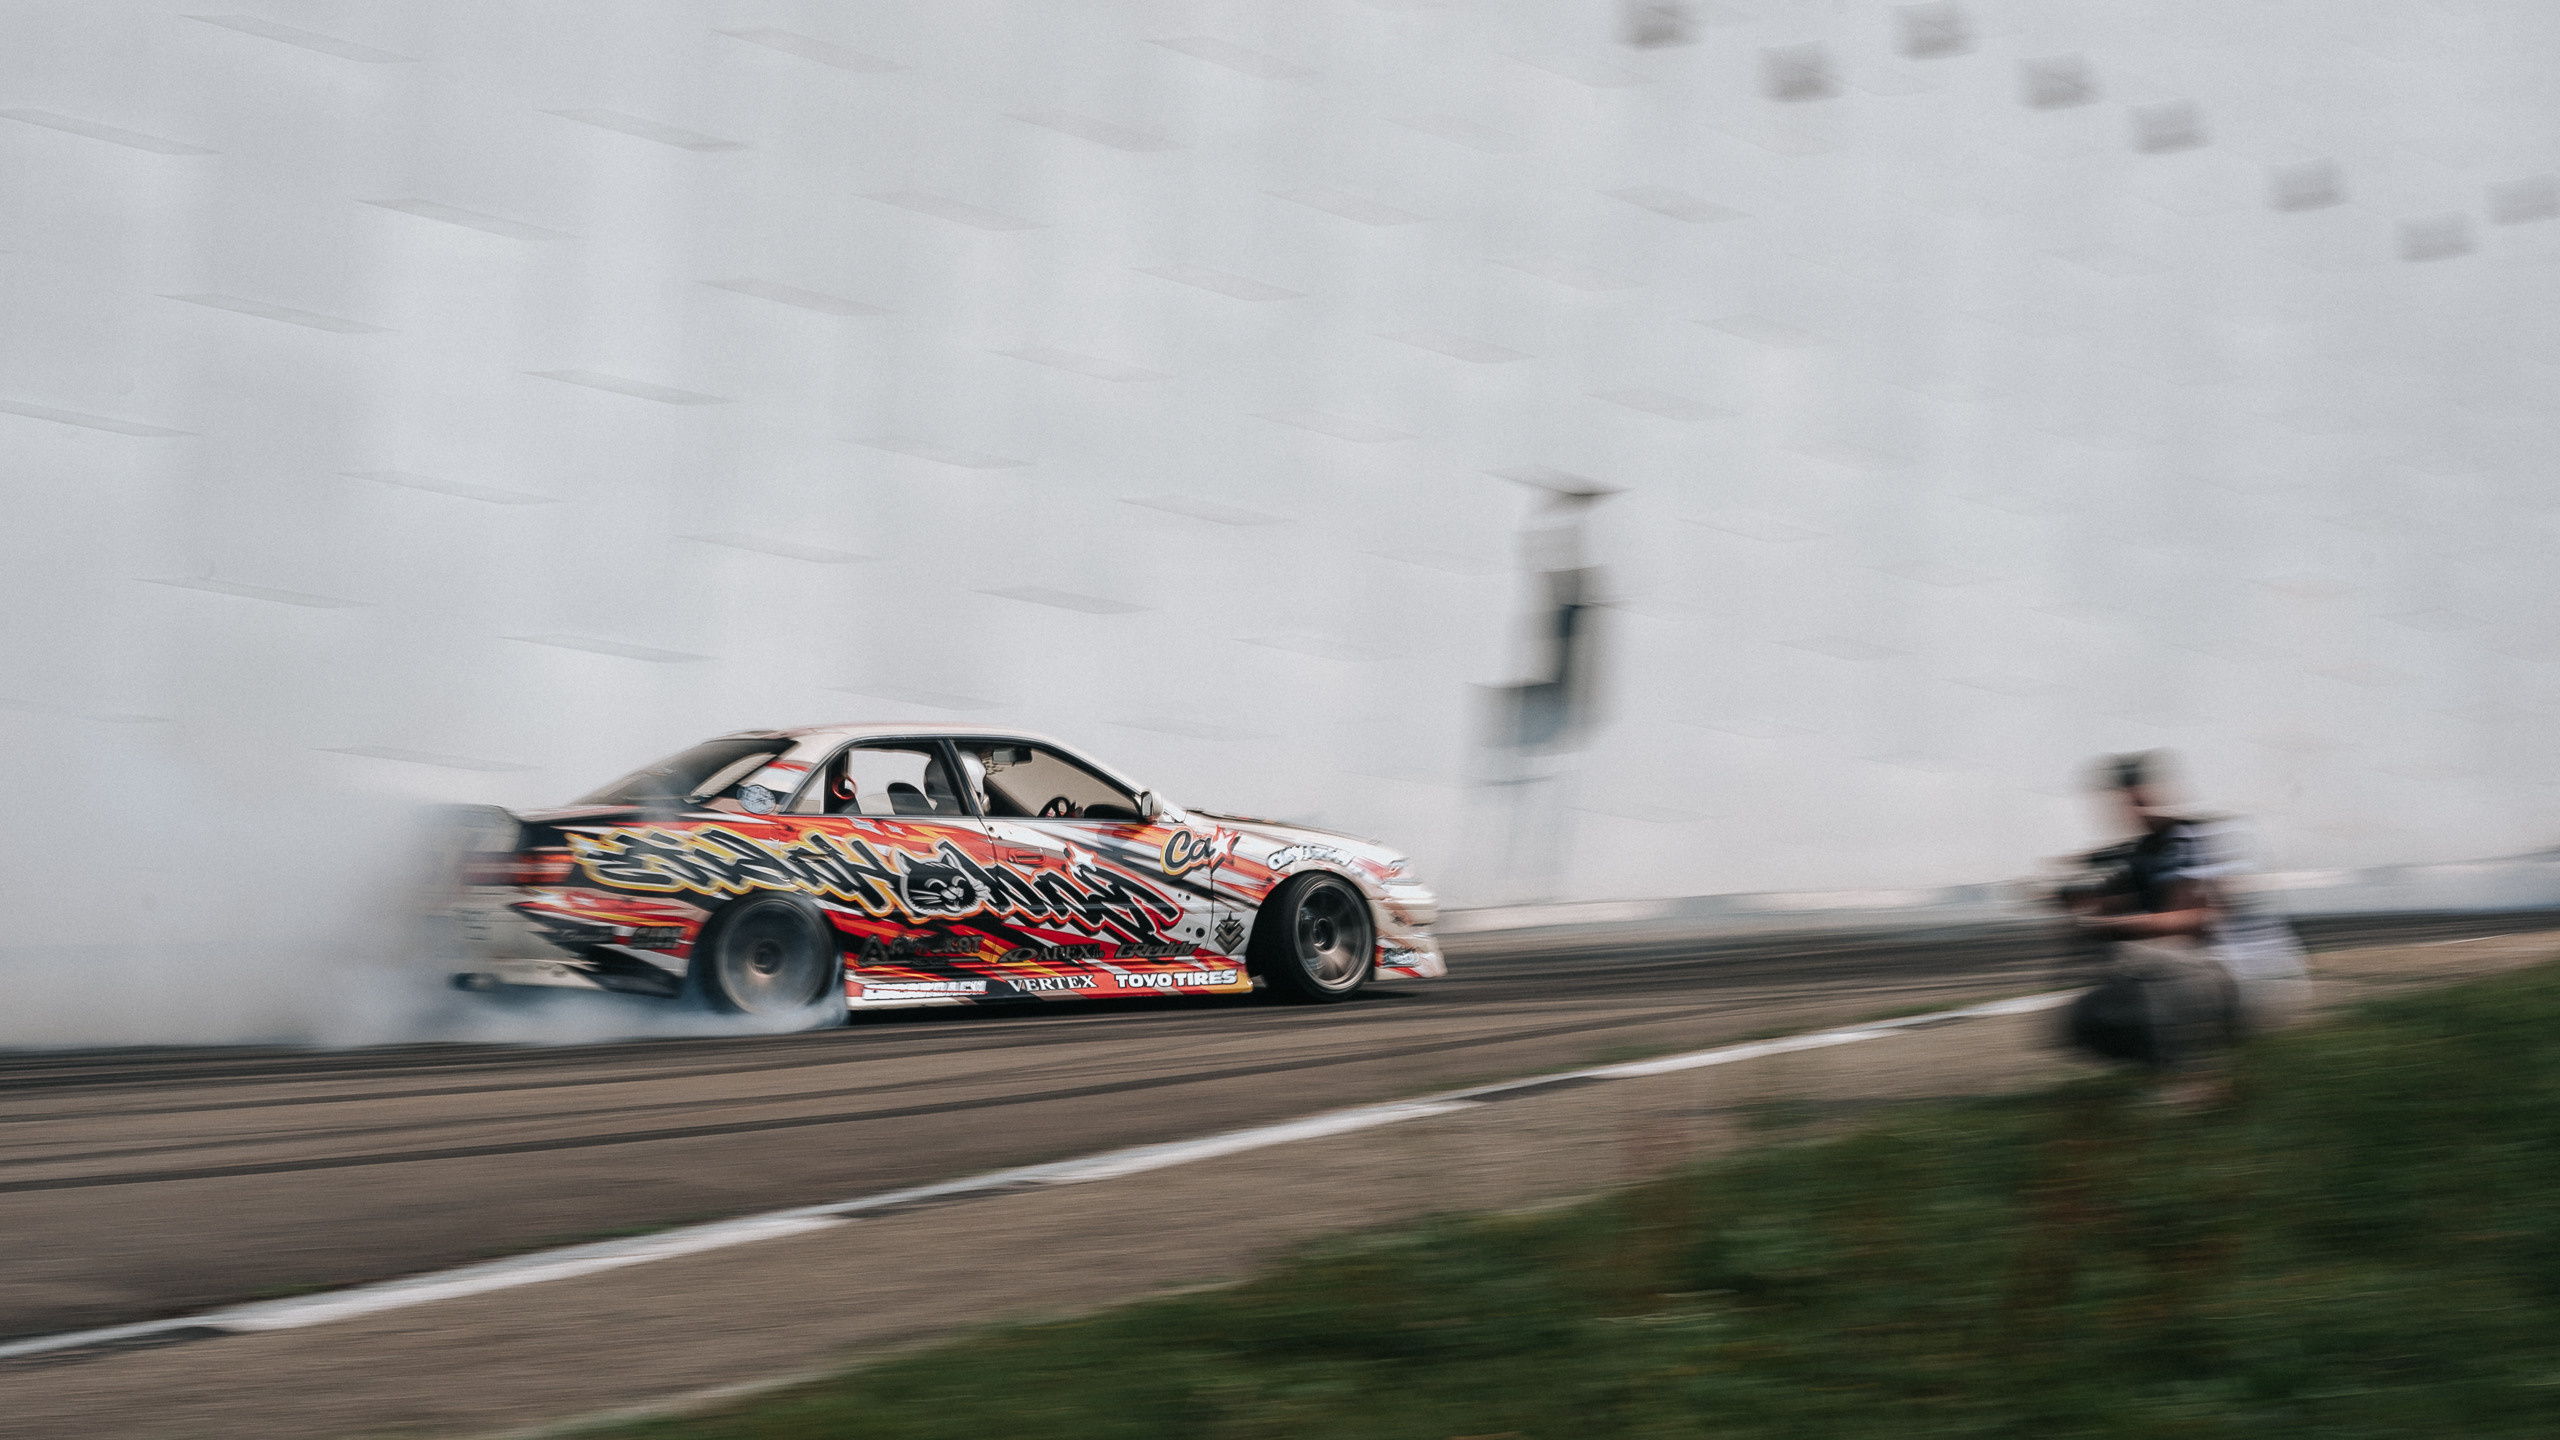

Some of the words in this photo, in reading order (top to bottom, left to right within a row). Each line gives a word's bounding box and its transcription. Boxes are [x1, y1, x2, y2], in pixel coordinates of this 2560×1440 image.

[1115, 941, 1200, 958] GReddy
[1008, 974, 1098, 993] VERTEX
[1115, 972, 1173, 988] TOYO
[1173, 969, 1238, 986] TIRES
